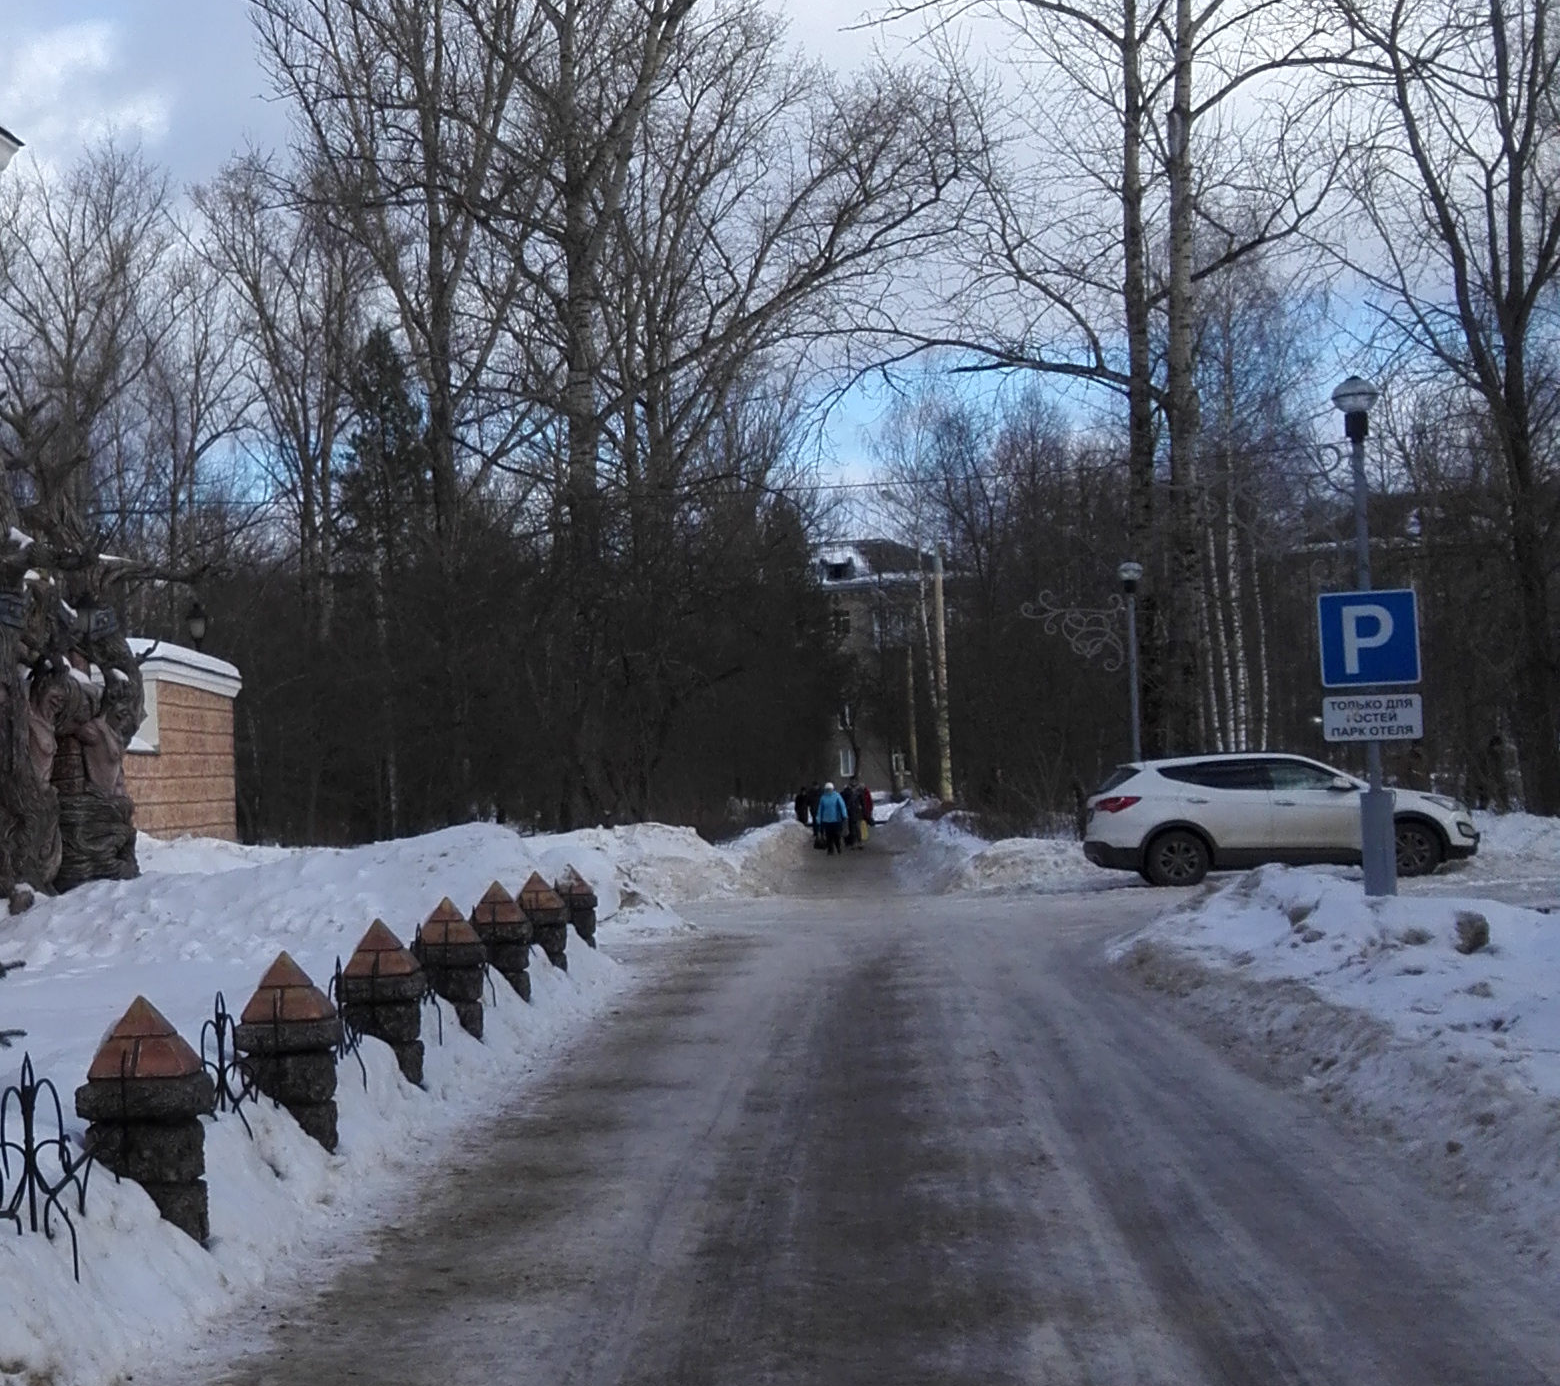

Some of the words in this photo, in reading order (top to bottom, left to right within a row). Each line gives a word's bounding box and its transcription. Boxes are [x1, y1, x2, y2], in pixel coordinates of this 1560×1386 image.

[1342, 604, 1394, 675] P
[1330, 699, 1383, 711] ТОЛЬКО
[1386, 698, 1413, 710] ДЛЯ
[1331, 726, 1366, 737] ПАРК
[1369, 725, 1414, 736] ОТЕЛЯ
